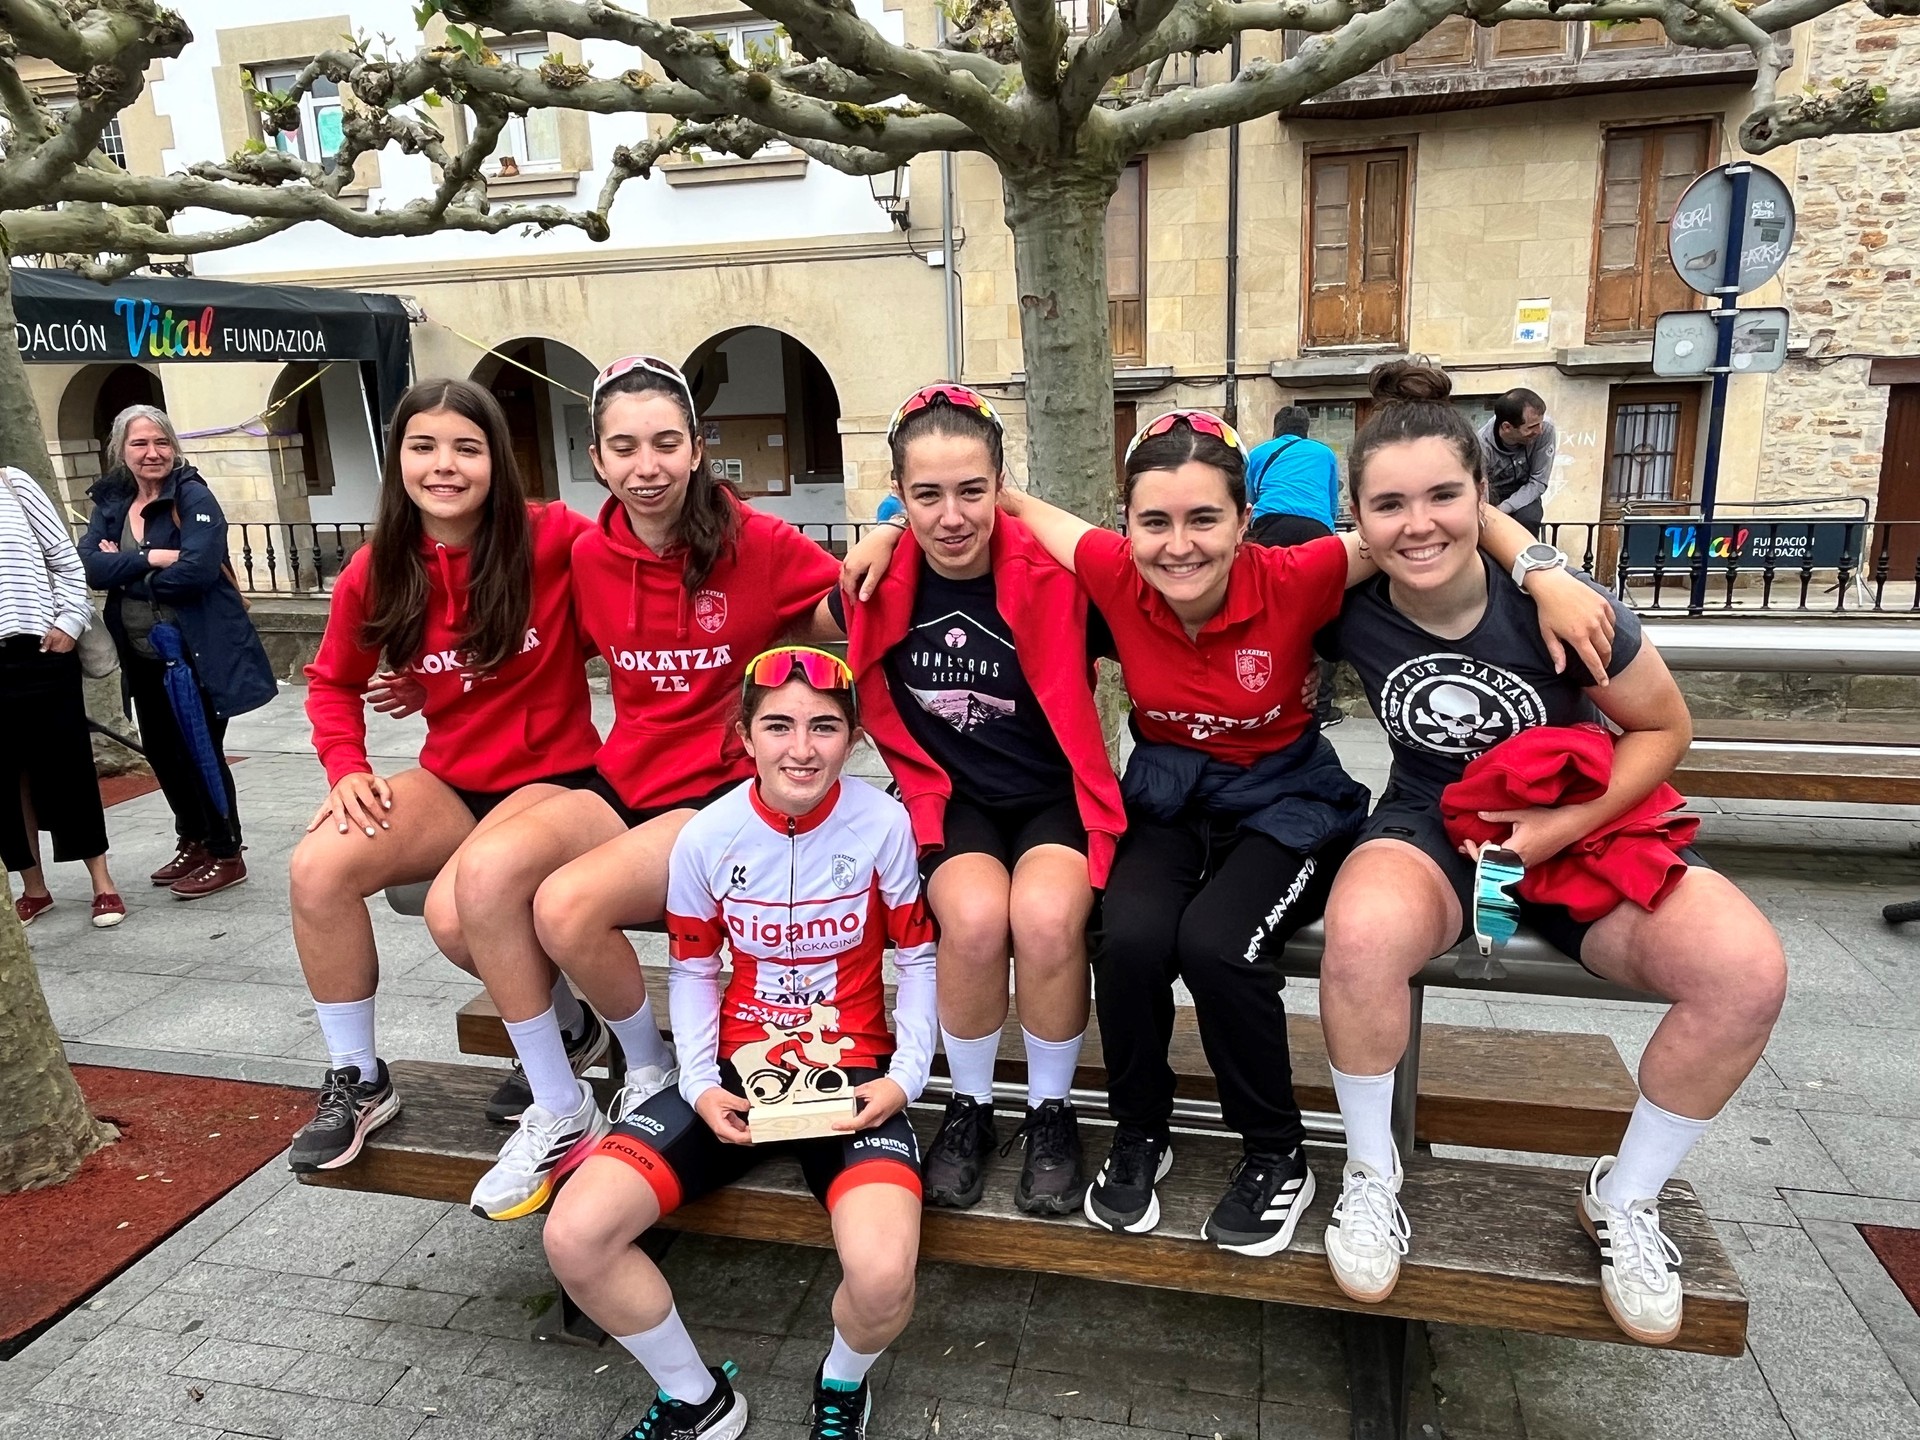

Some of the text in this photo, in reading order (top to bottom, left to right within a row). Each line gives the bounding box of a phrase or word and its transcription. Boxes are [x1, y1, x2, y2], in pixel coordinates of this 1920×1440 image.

[15, 297, 327, 358] DACIÓN Vital FUNDAZIOA
[1665, 525, 1749, 559] Vial
[411, 627, 542, 675] LOKA
[609, 644, 732, 671] LOKATZA
[459, 671, 498, 693] Z
[650, 675, 690, 692] ZE
[1460, 662, 1523, 701] DANA
[1145, 704, 1281, 731] OKATZA
